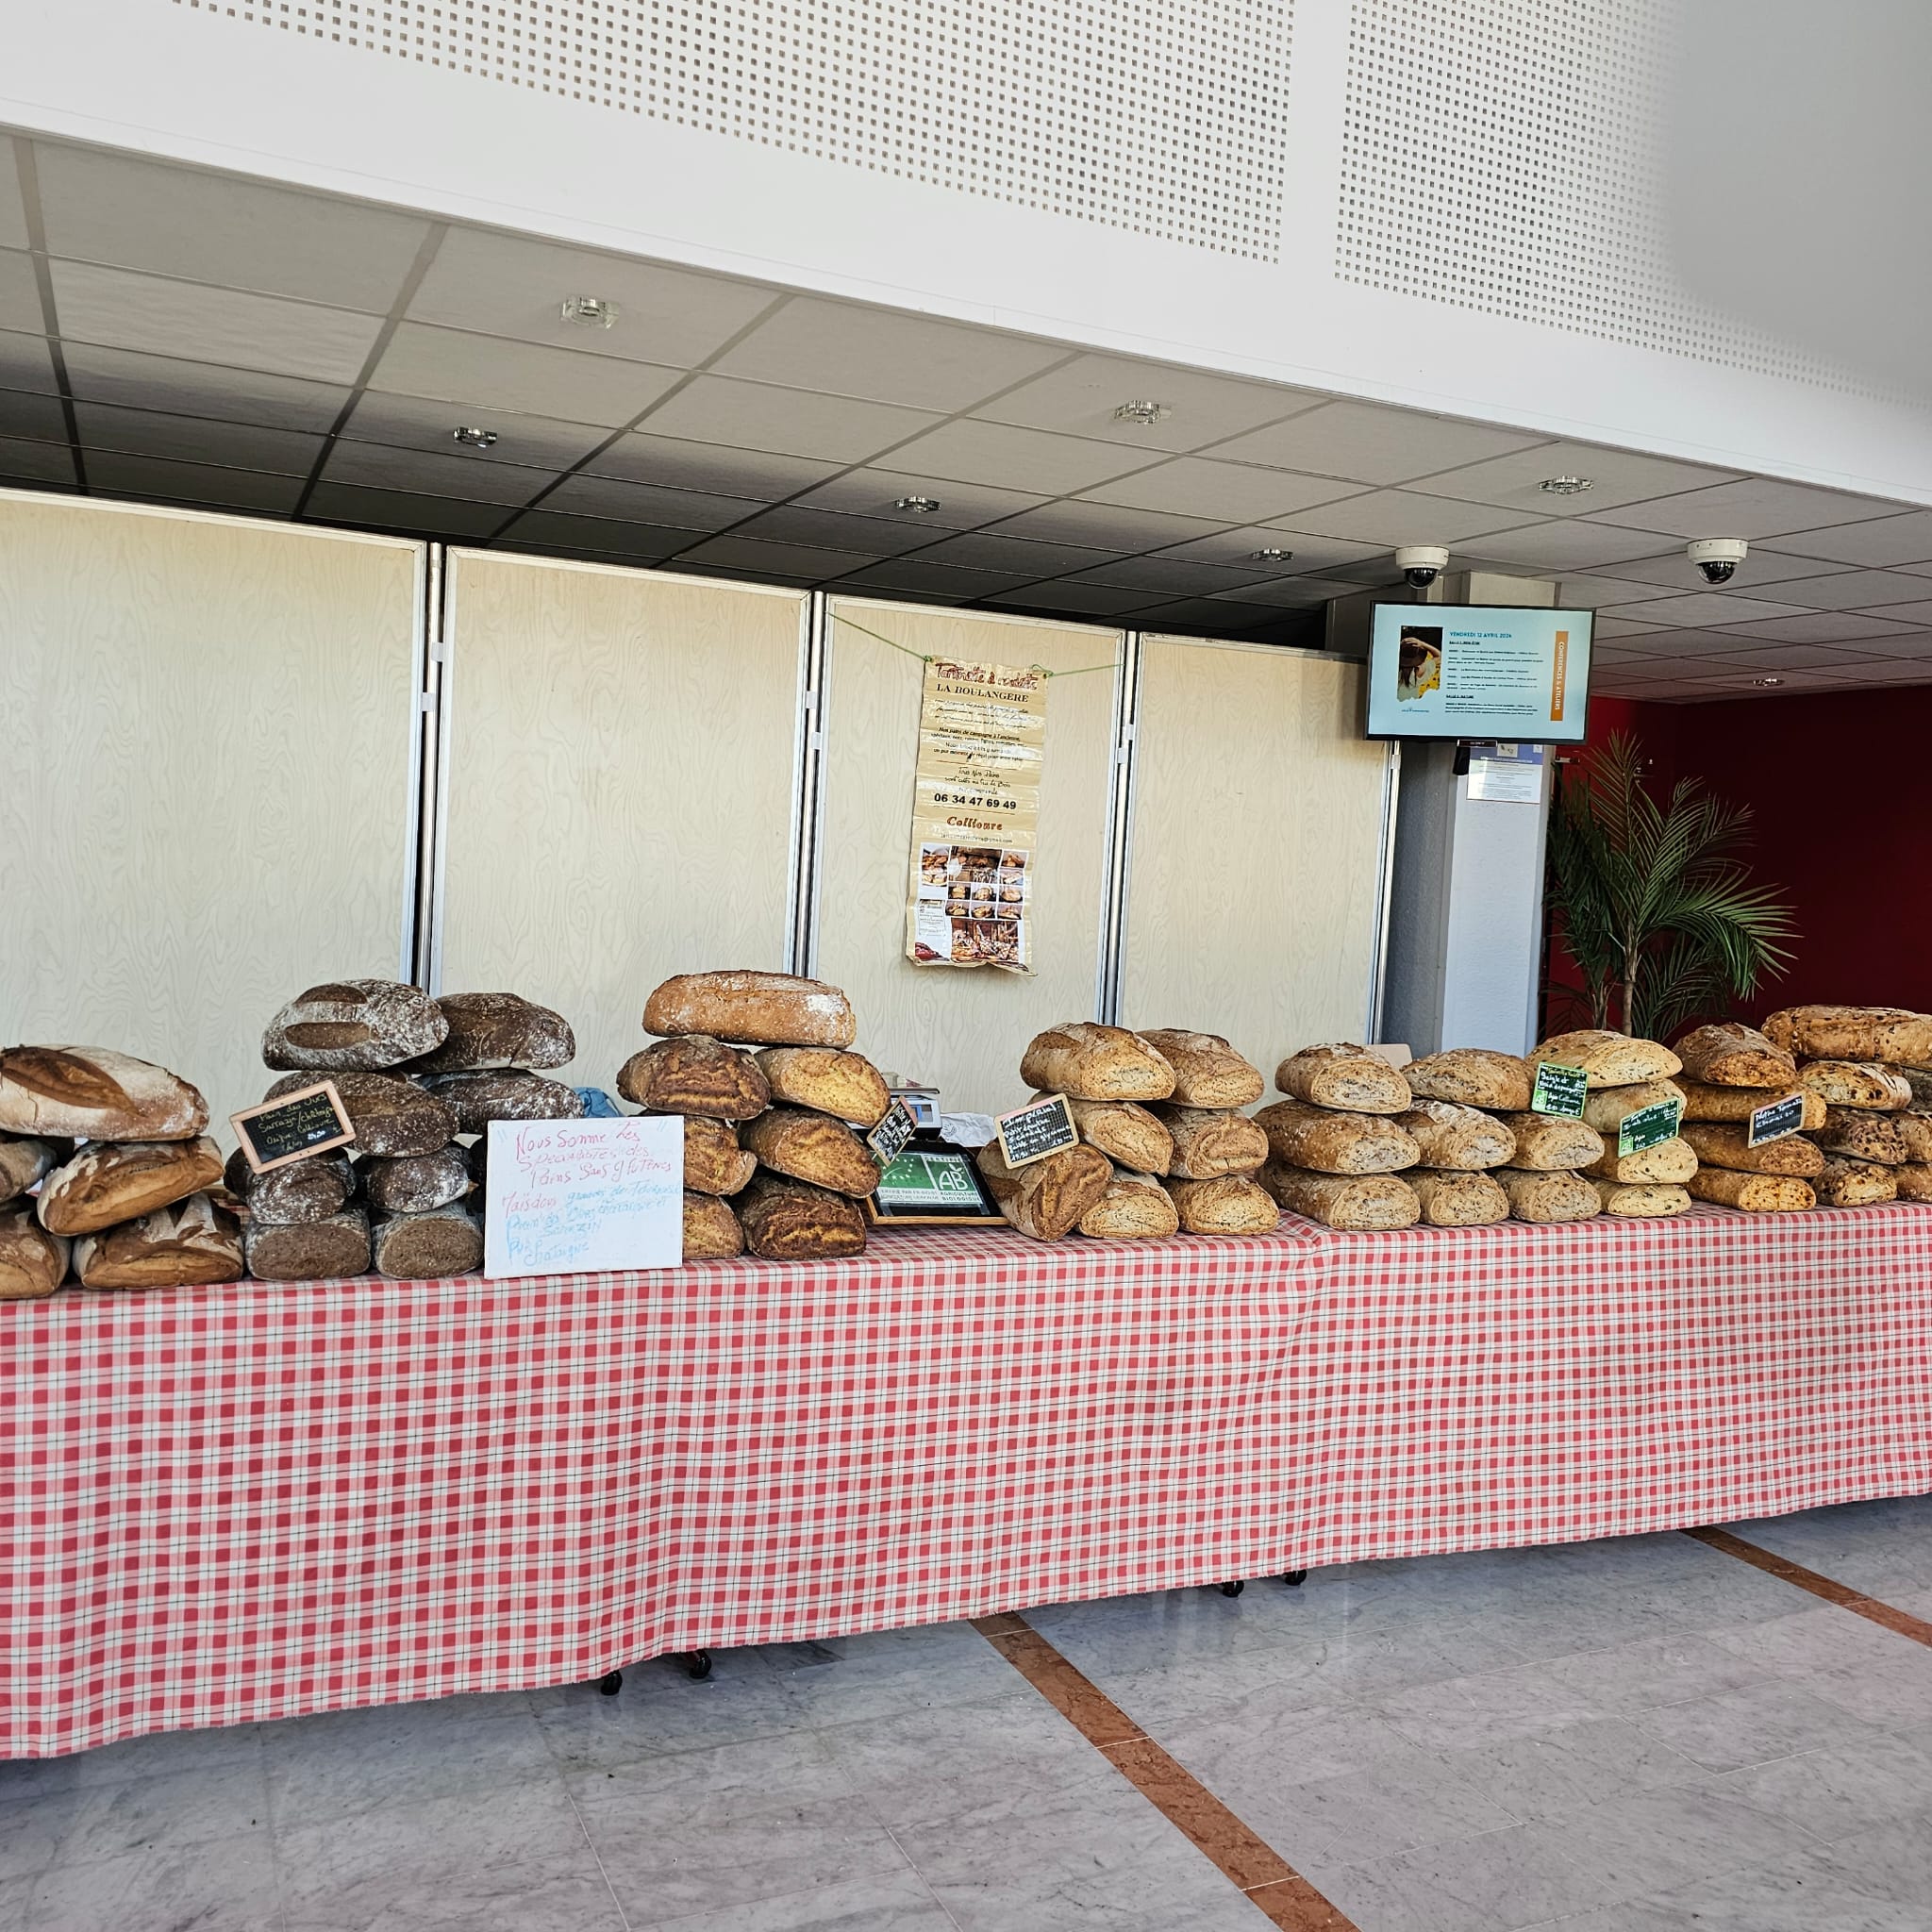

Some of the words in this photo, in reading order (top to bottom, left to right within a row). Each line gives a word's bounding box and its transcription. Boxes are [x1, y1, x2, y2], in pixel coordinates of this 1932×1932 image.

[937, 683, 951, 692] LA
[955, 686, 1029, 703] BOULANGERE
[934, 792, 948, 803] 06
[952, 794, 966, 804] 34
[969, 796, 983, 806] 47
[986, 798, 1000, 808] 69
[1003, 800, 1017, 809] 49
[946, 816, 1003, 830] Collioure
[516, 1126, 552, 1161] Nous
[939, 1169, 969, 1191] AB
